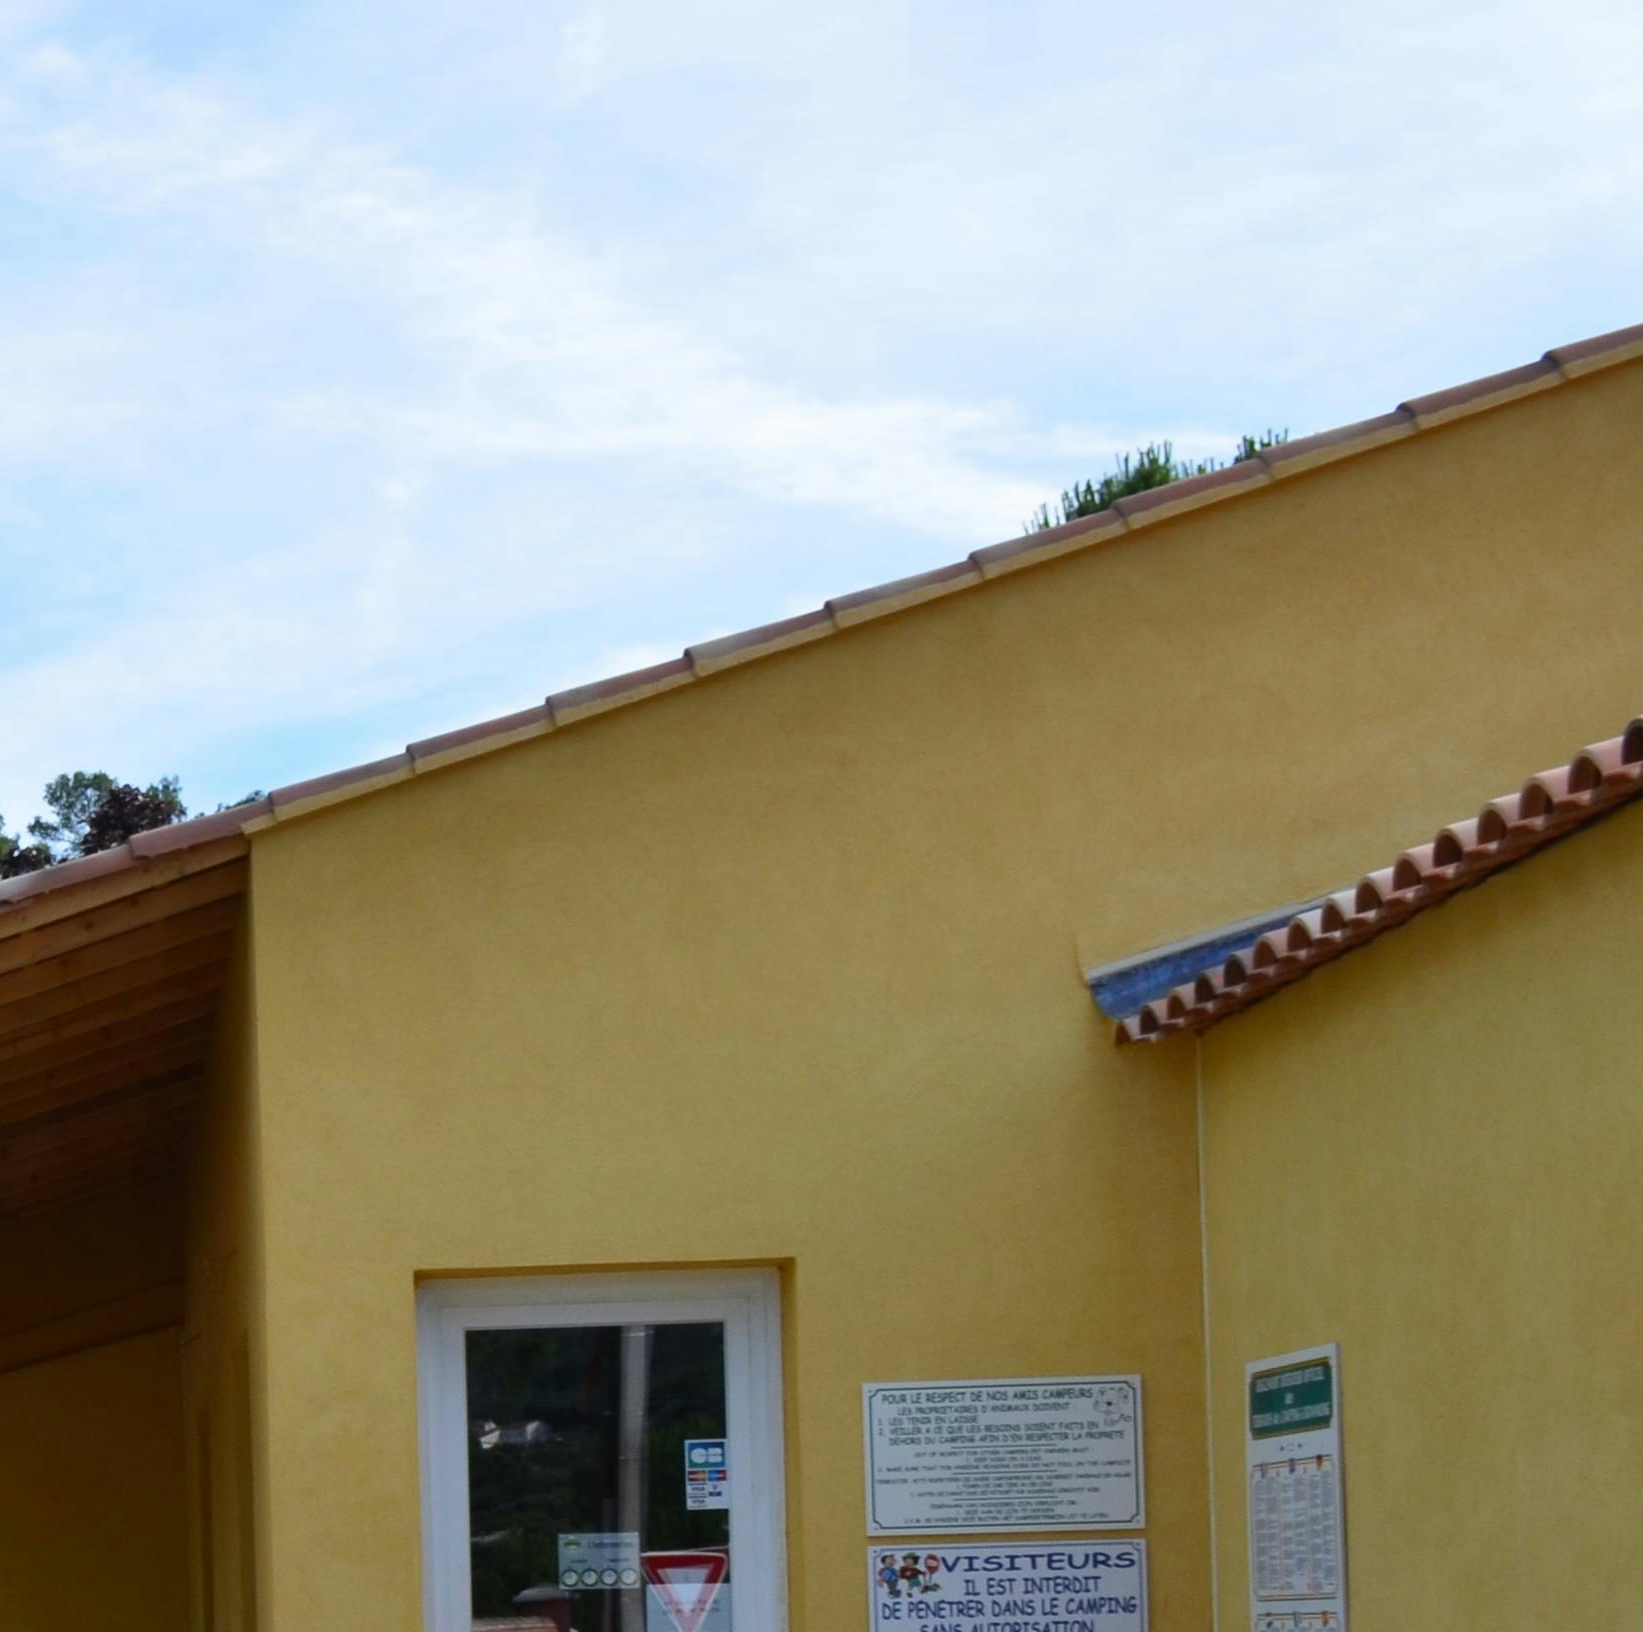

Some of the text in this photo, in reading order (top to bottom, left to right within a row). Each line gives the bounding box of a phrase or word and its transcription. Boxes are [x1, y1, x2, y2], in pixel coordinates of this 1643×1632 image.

[881, 1388, 1093, 1405] POUR LE RESPECT DE NOS AMIS CAMPEURS
[690, 1447, 723, 1464] CB
[941, 1552, 1135, 1572] VISITEURS
[963, 1575, 1102, 1596] IL EST INTERDIT
[882, 1601, 902, 1620] DE
[991, 1598, 1035, 1617] DANS
[1041, 1597, 1060, 1616] LE
[1065, 1596, 1138, 1615] CAMPING
